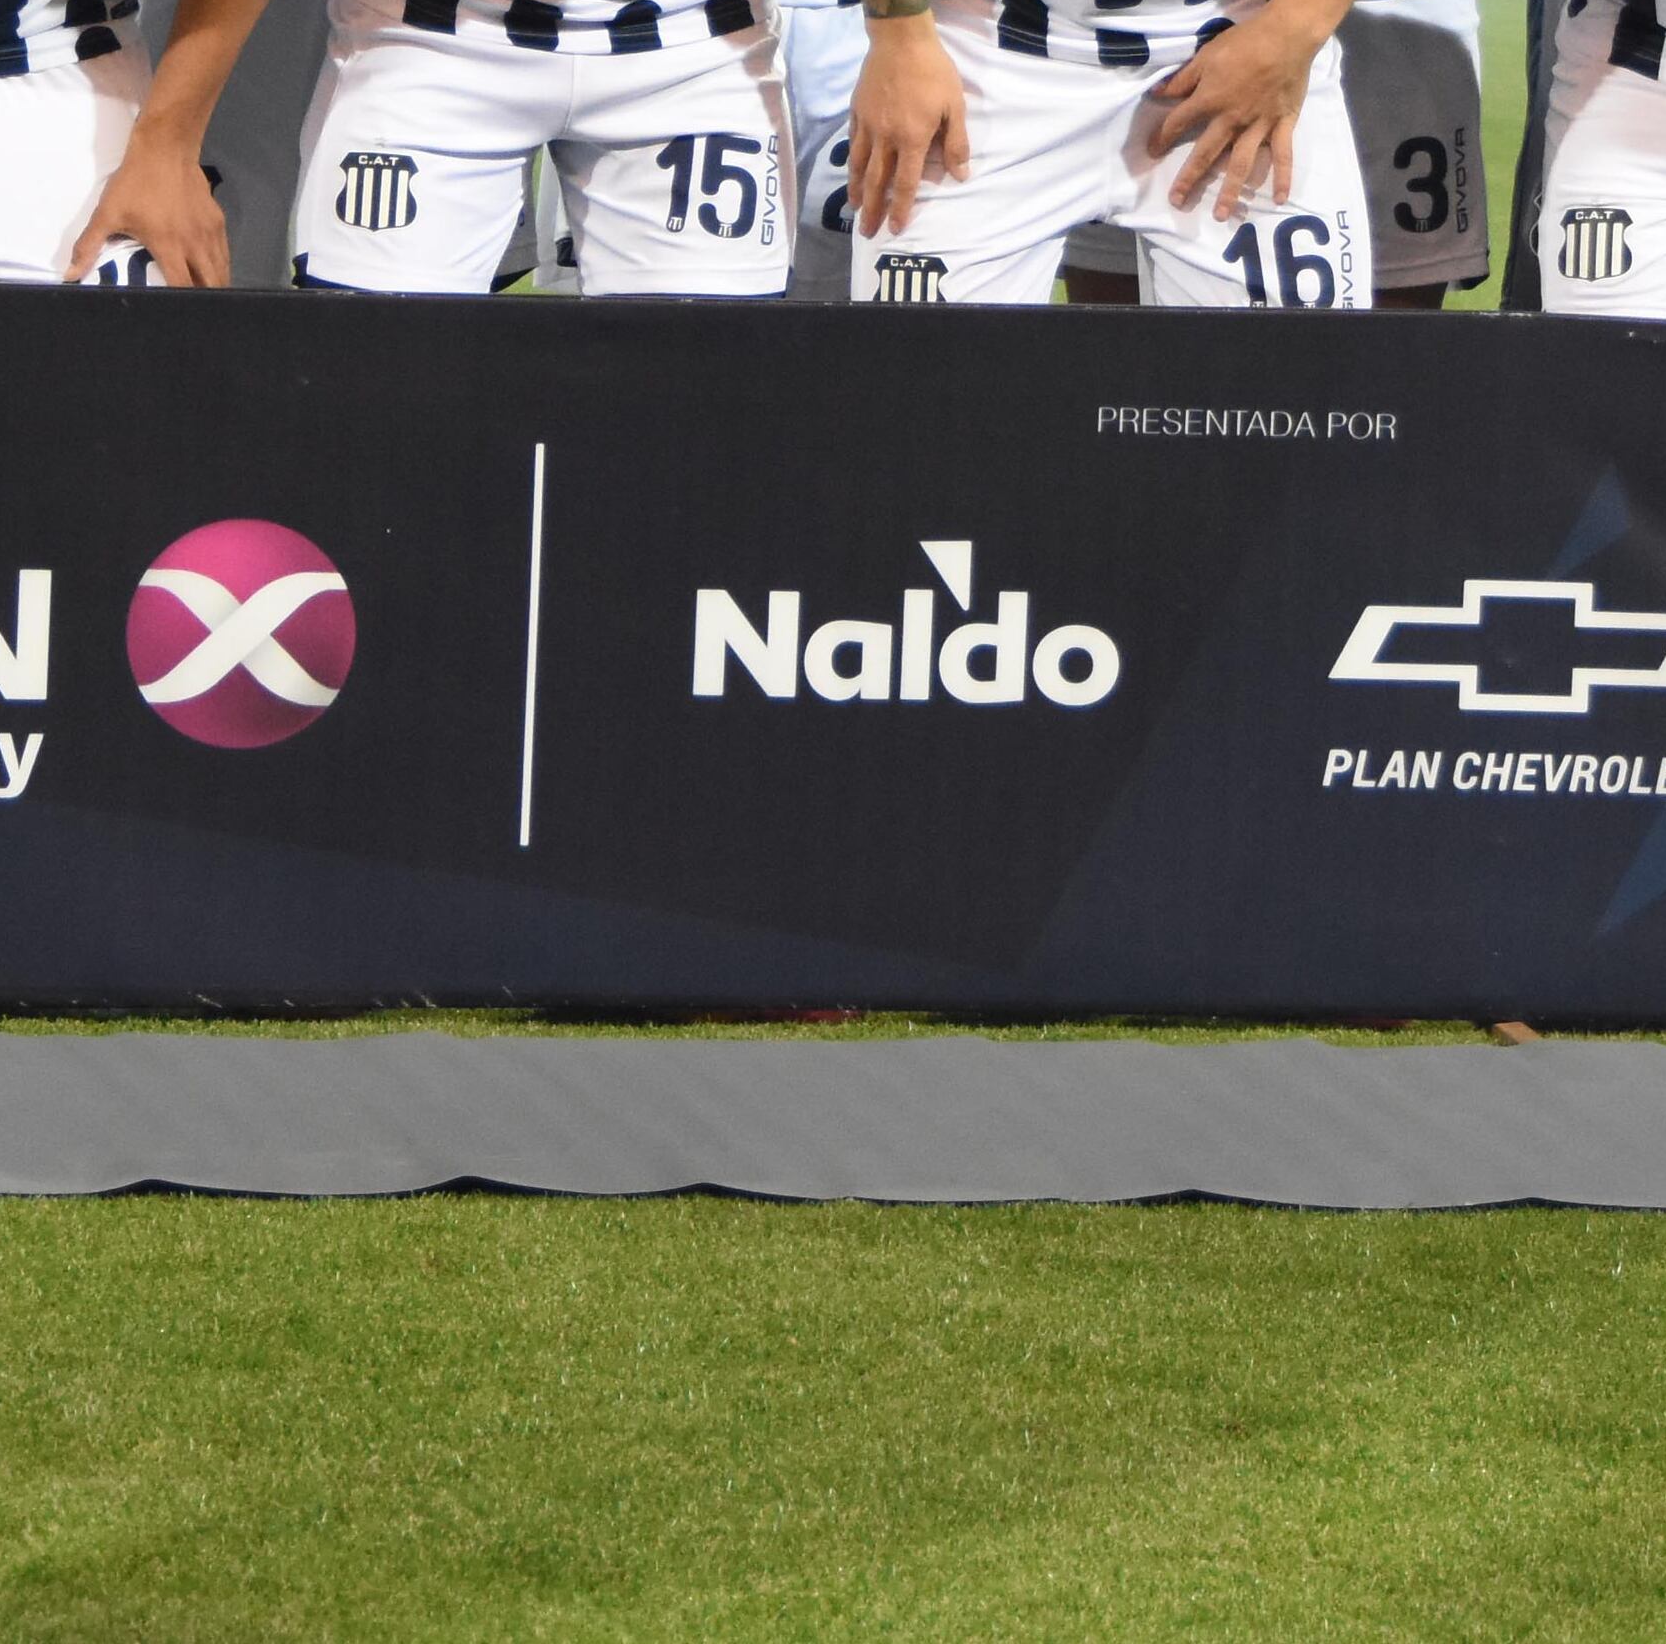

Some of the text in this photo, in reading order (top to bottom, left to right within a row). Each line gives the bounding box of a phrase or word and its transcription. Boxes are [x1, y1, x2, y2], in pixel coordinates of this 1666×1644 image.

[358, 154, 398, 167] C.A.T
[655, 134, 762, 238] 15
[760, 134, 780, 246] GIVOVA
[1393, 136, 1448, 234] 3
[1455, 127, 1471, 234] GIVOVA
[889, 256, 928, 269] C.A.T
[1222, 215, 1335, 309] 16
[1574, 209, 1615, 222] C.A.T
[1097, 406, 1397, 440] PRESENTADA POR
[692, 540, 1120, 706] Naldo
[1322, 749, 1439, 791] PLAN
